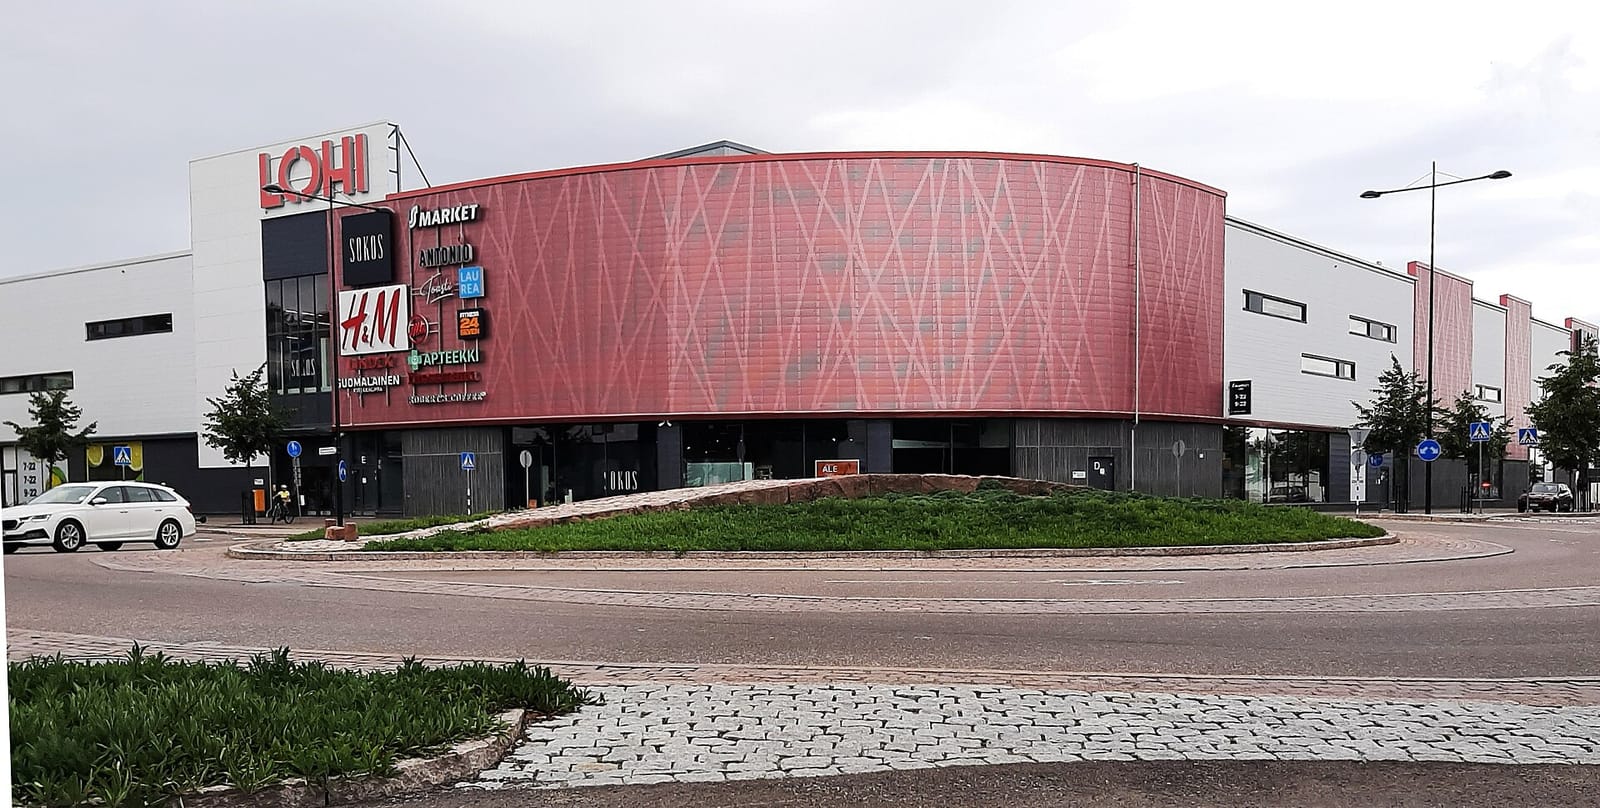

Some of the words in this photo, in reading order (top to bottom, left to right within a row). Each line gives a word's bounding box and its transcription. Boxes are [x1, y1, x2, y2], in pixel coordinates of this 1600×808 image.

[259, 133, 368, 209] LOHI
[349, 233, 384, 263] SOKOS
[419, 243, 473, 268] ANTONIO
[460, 271, 479, 282] LAU
[461, 283, 480, 295] REA
[341, 288, 400, 350] H&M
[460, 317, 480, 329] 24
[423, 348, 479, 366] APTEEKKI
[361, 456, 367, 464] E
[1093, 461, 1101, 471] D
[23, 462, 36, 471] 7-22
[822, 465, 838, 473] ALE
[23, 475, 37, 484] 7-22
